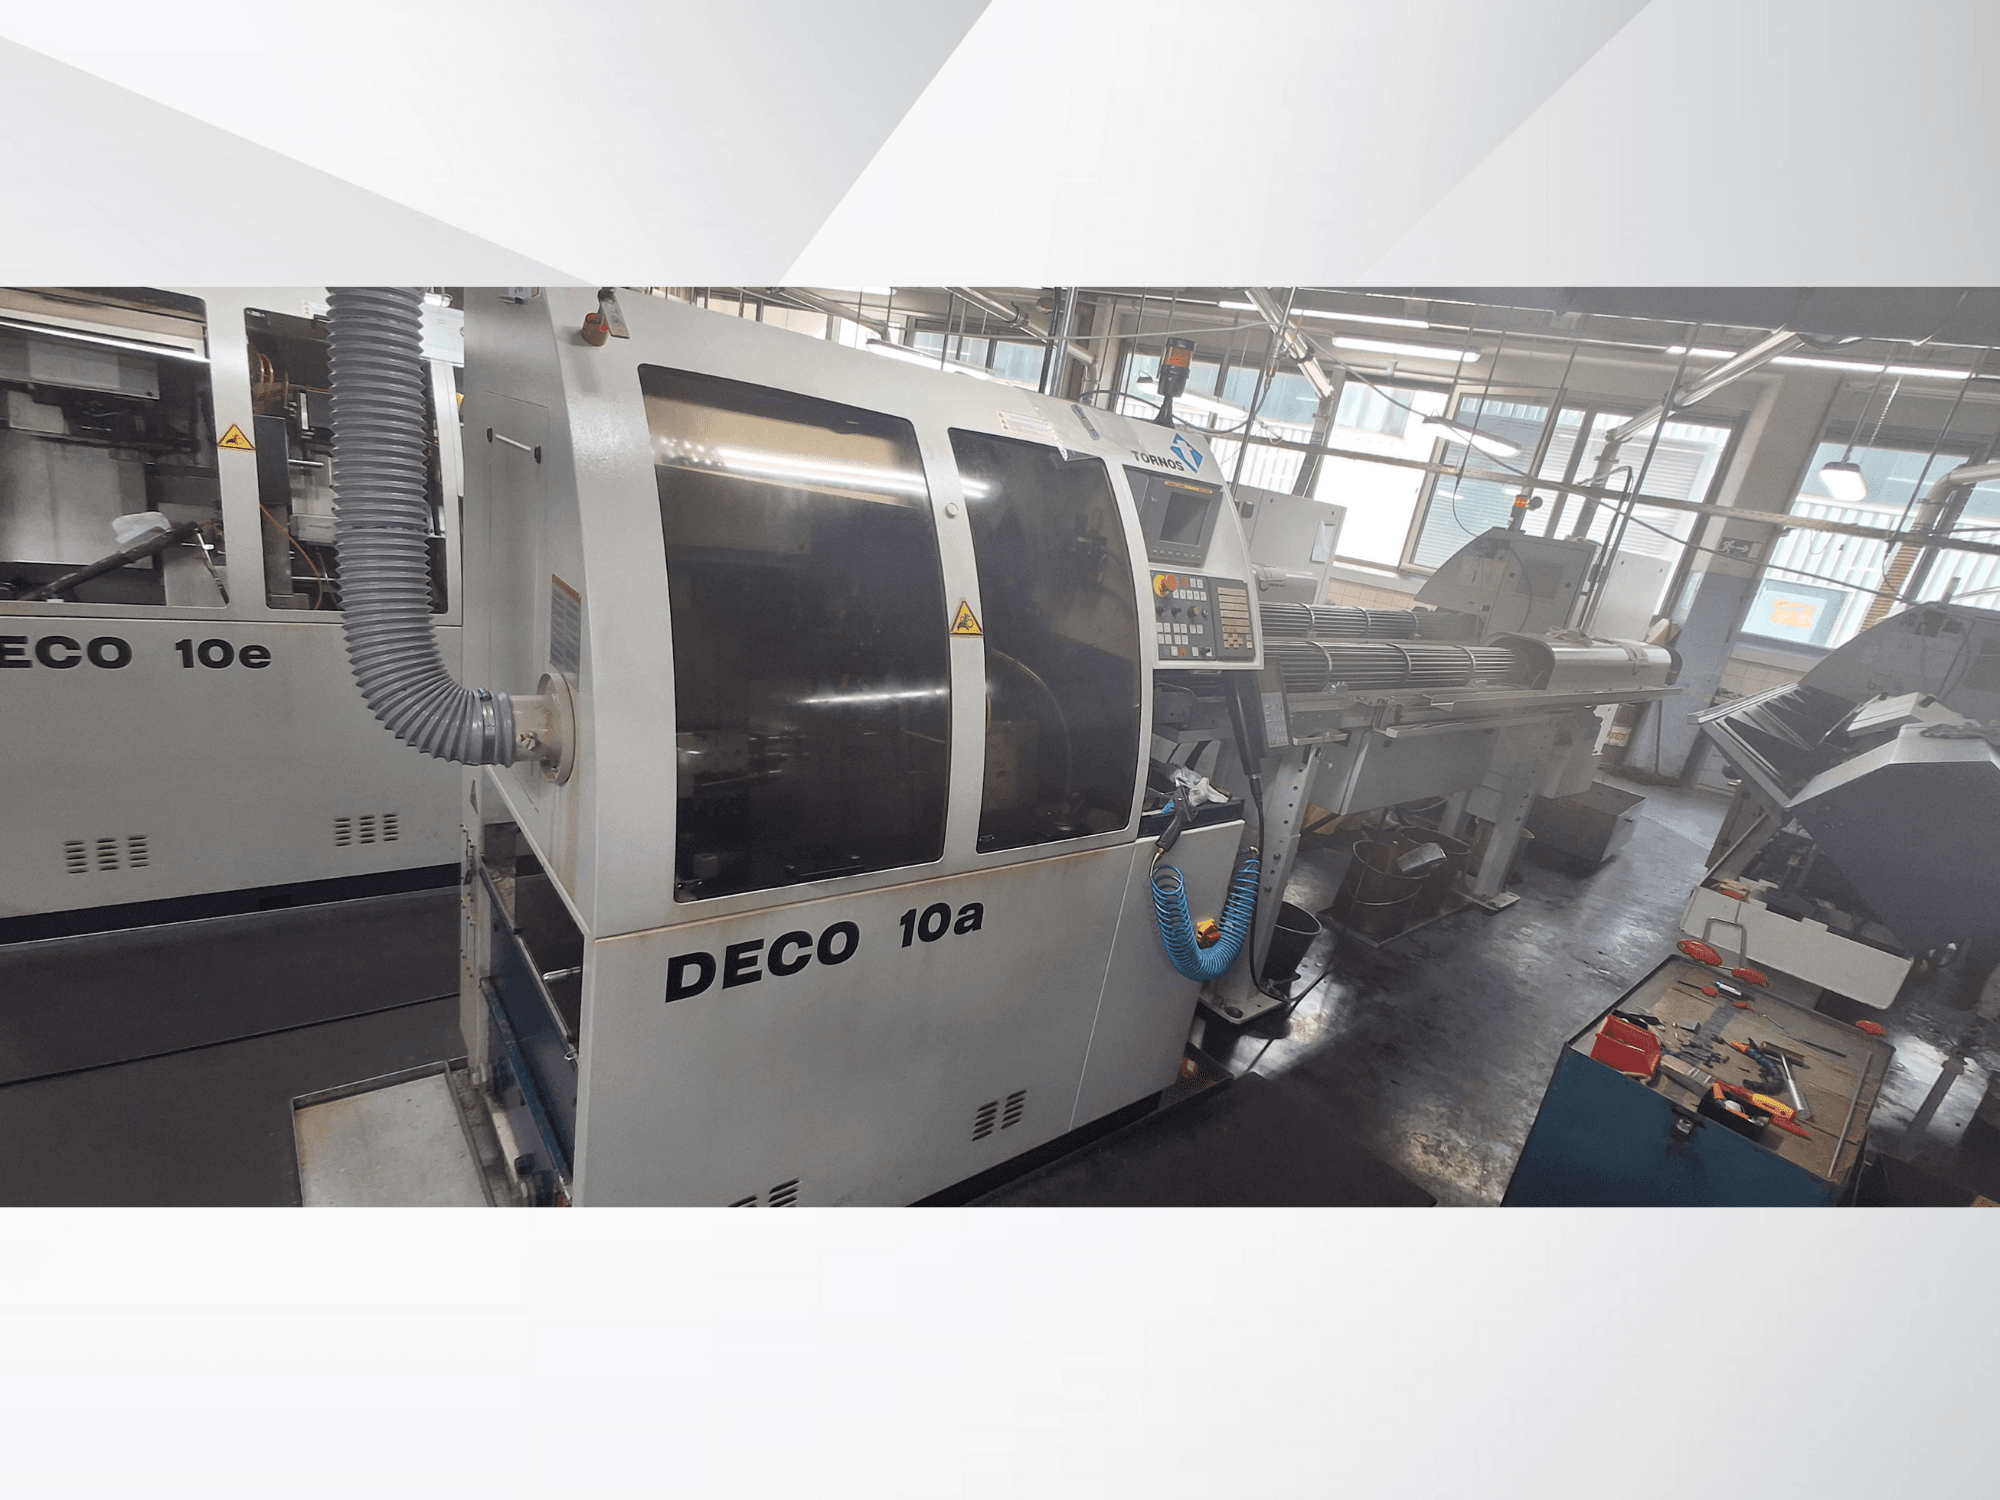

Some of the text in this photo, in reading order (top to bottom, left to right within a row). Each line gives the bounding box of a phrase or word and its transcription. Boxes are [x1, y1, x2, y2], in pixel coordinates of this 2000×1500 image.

[1131, 450, 1185, 471] TORNOS
[175, 638, 272, 669] 10e
[665, 902, 984, 1003] DECO 10a
